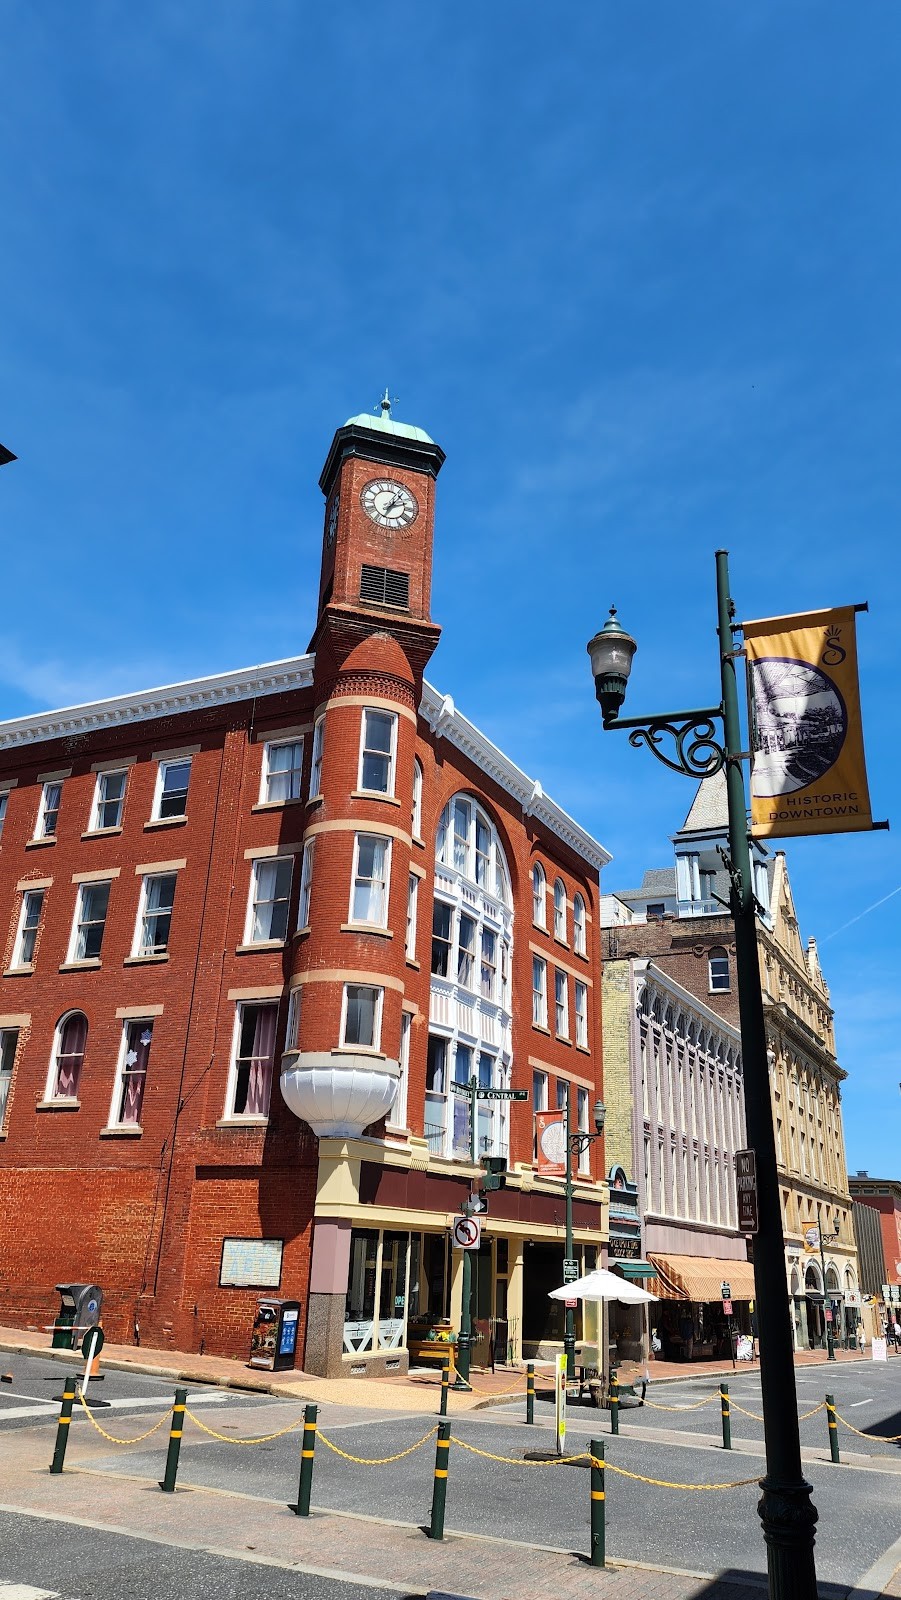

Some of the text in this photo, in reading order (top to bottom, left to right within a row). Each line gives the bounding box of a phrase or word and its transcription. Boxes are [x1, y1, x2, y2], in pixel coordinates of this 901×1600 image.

[822, 636, 846, 665] S
[786, 792, 858, 806] HISTORIC
[769, 805, 859, 820] DOWNTOWN
[741, 1157, 750, 1173] NO
[737, 1174, 756, 1192] PARKING
[742, 1192, 751, 1204] ANY
[742, 1205, 753, 1217] TIME
[395, 1295, 405, 1306] OPE
